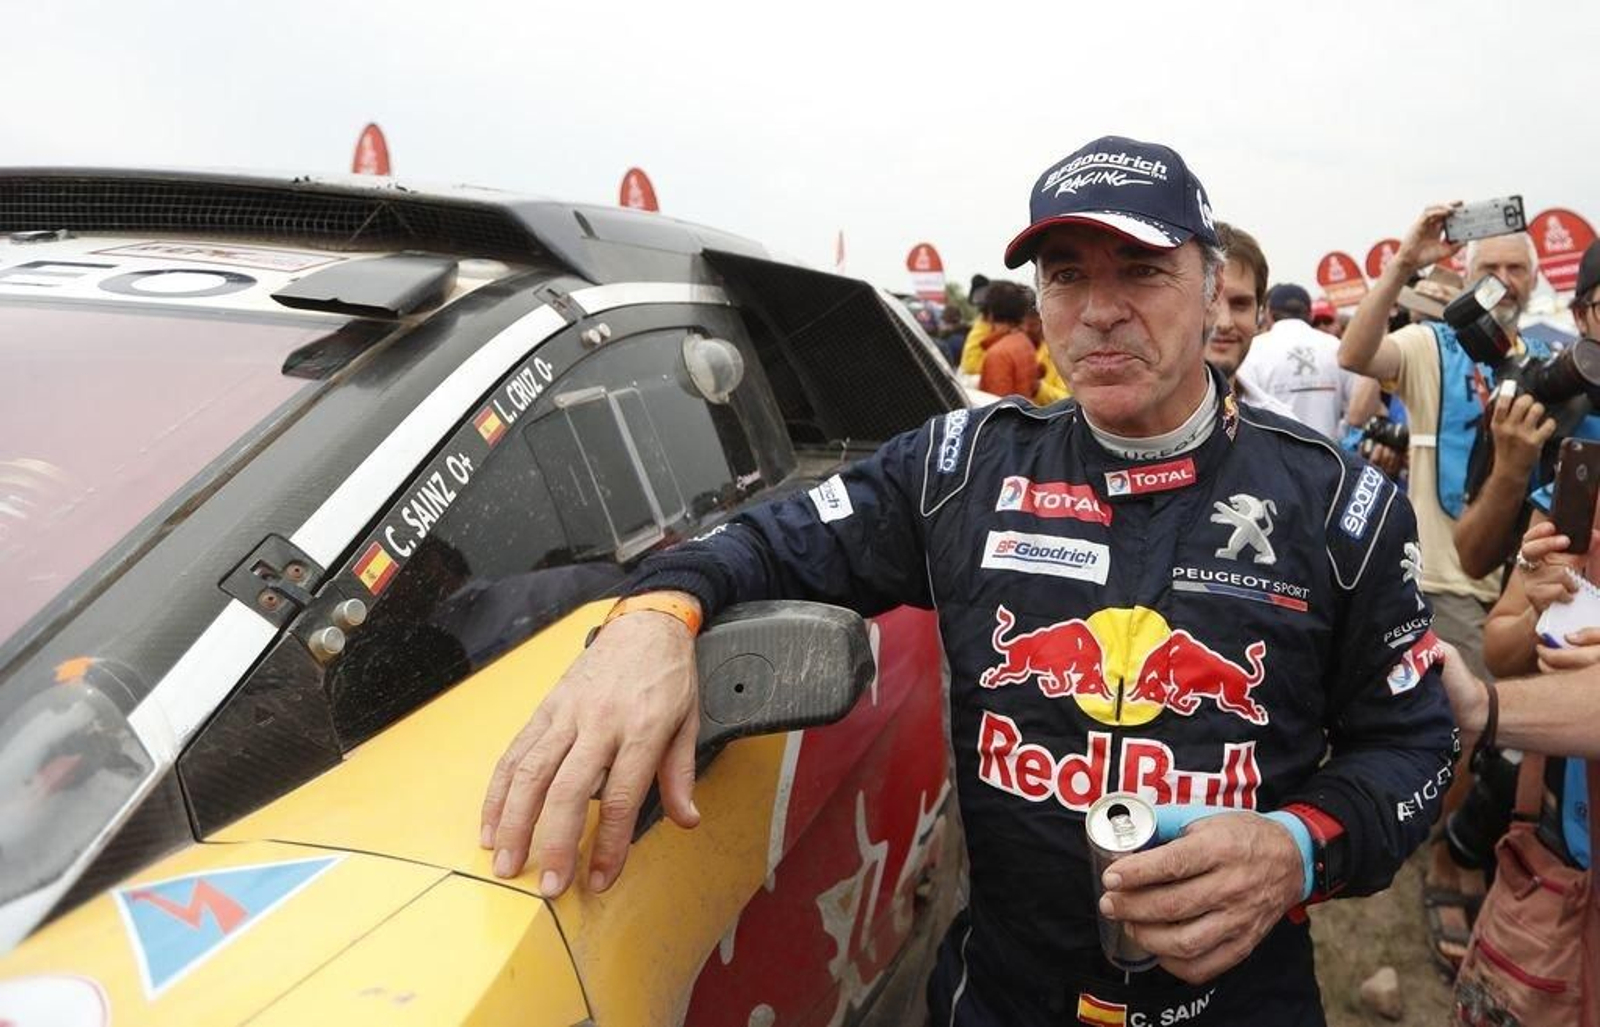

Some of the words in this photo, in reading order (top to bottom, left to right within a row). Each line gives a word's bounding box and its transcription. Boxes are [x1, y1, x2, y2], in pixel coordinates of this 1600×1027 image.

[1054, 169, 1154, 198] RACING
[506, 366, 543, 412] CRUZ
[1131, 468, 1193, 487] TOTAL
[385, 525, 417, 557] C.
[401, 470, 457, 539] SAINZ
[1030, 489, 1107, 518] TOTAL
[1344, 465, 1382, 535] sparco
[995, 540, 1099, 565] BFGoodrich
[1172, 566, 1271, 590] PEUGEOT
[1272, 581, 1310, 600] SPORT
[978, 711, 1112, 812] Red
[1121, 738, 1262, 811] Bull
[1160, 988, 1216, 1027] SAIN
